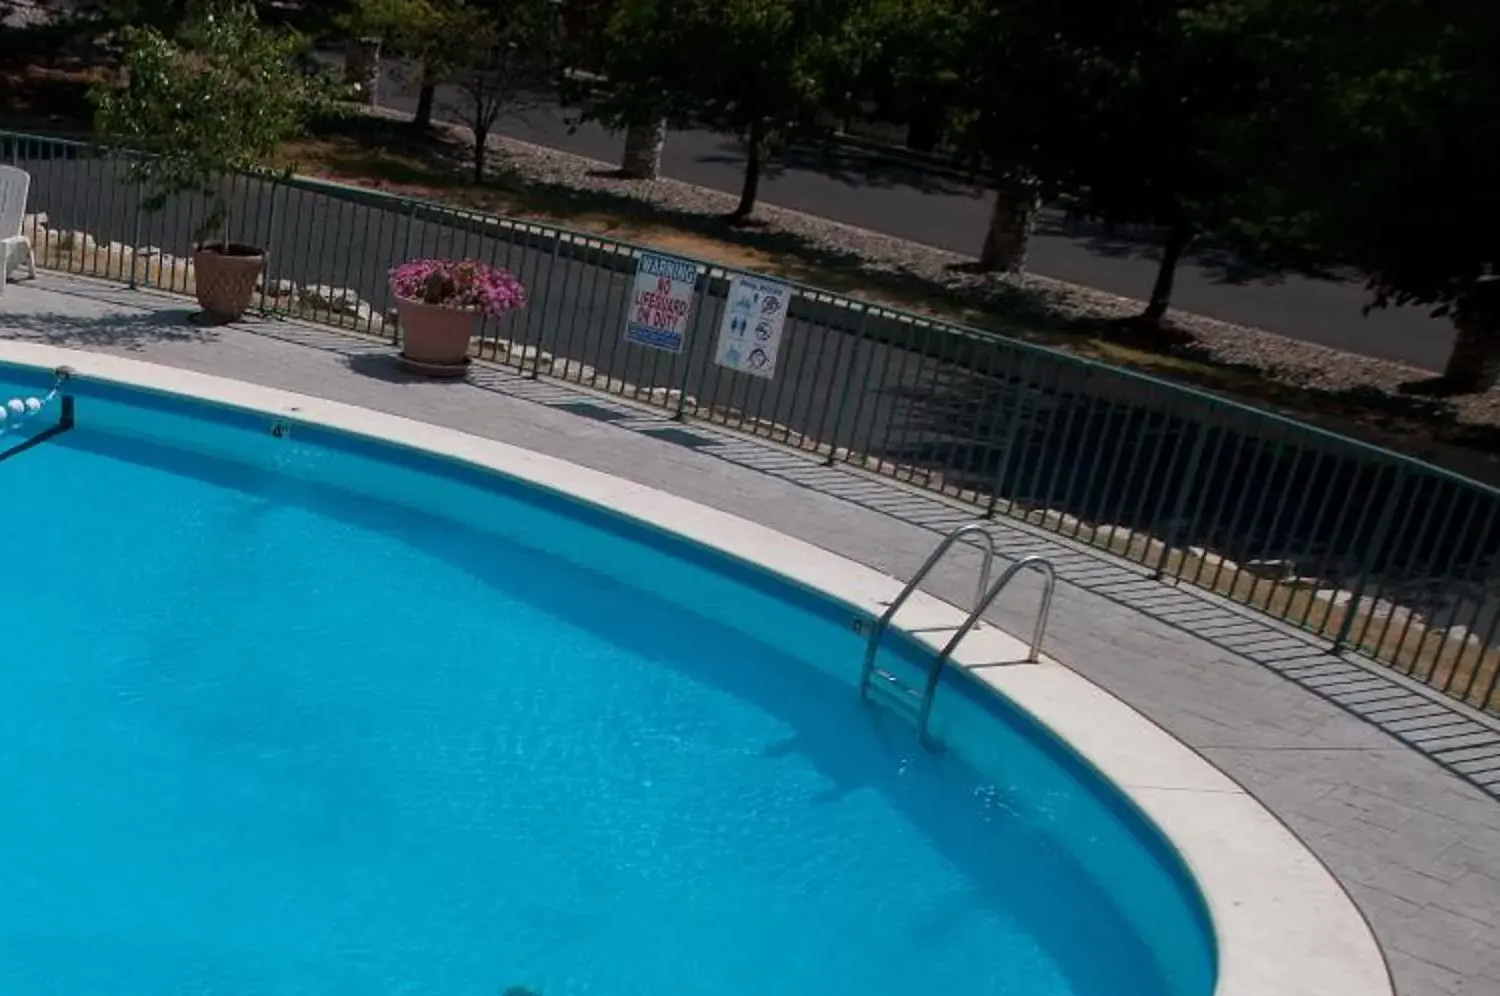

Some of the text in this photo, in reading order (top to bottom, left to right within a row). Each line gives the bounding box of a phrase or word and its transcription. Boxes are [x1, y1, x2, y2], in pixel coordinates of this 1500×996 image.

[638, 255, 695, 285] WARNING
[657, 276, 671, 295] NO
[637, 308, 678, 332] ON DUTY
